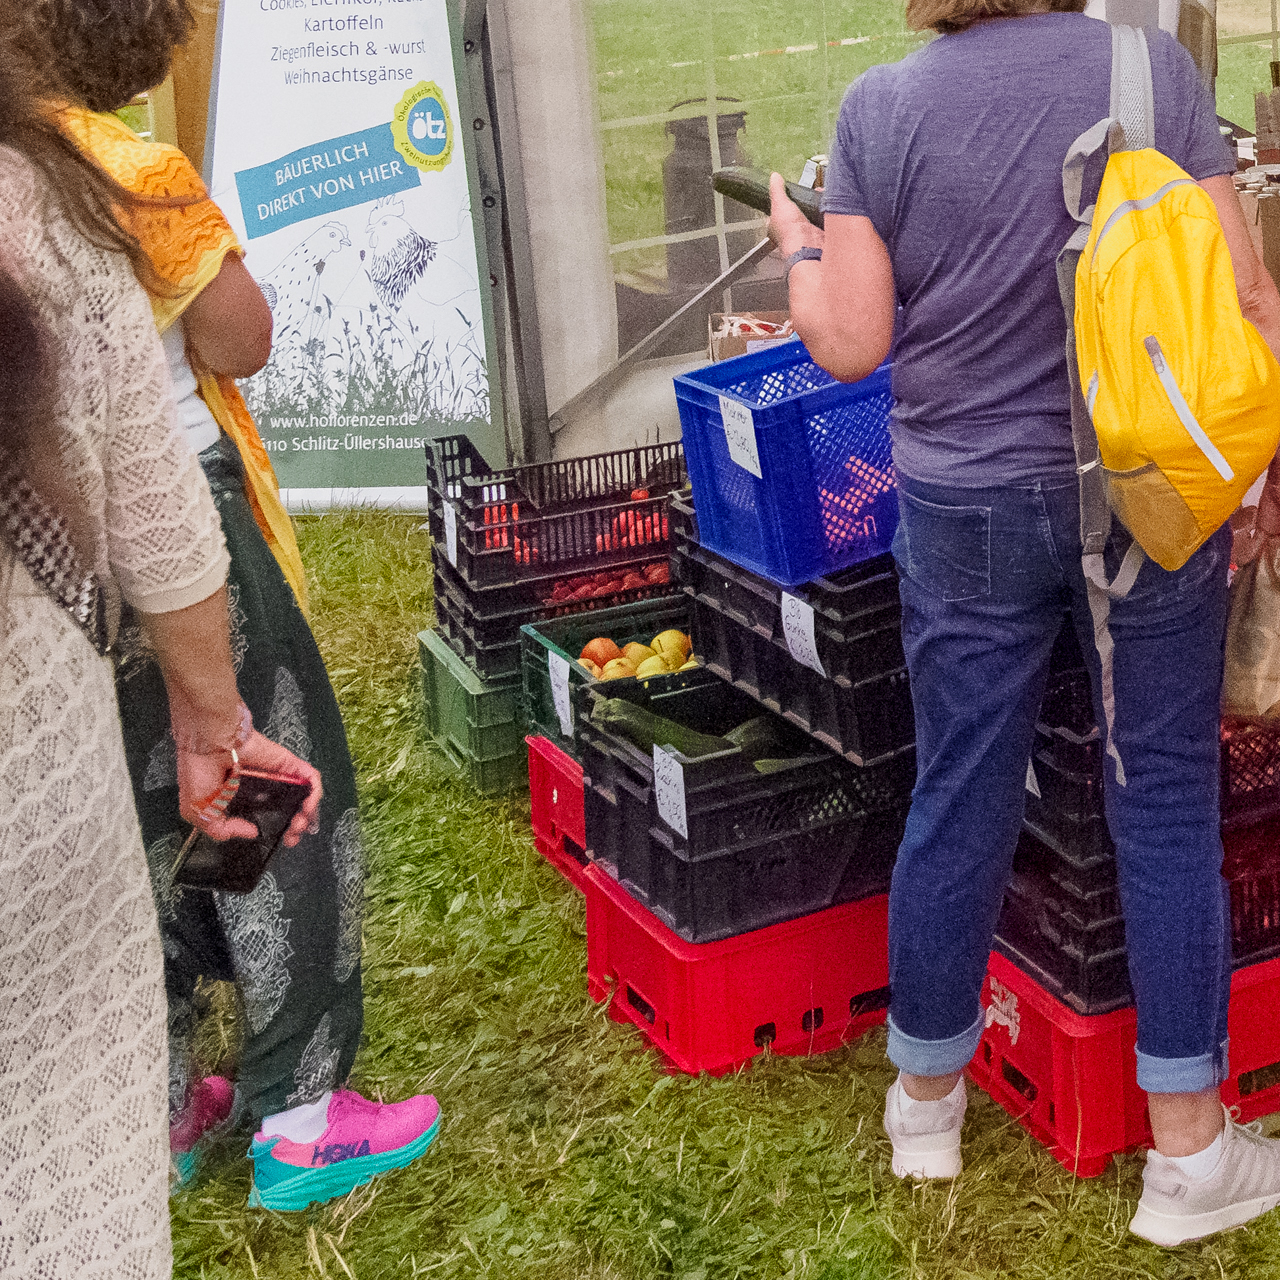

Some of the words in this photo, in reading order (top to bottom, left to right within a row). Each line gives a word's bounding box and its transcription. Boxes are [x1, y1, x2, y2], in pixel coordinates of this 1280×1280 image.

[304, 14, 385, 33] Kartoffeln
[270, 40, 360, 64] Ziegenfleisch
[365, 40, 378, 56] &
[383, 38, 427, 55] -wurst
[284, 65, 413, 86] Weihnachtsgänse
[274, 140, 369, 186] BÄUERLICH
[257, 187, 306, 221] DIREKT
[309, 173, 356, 200] VON
[359, 160, 404, 187] HIER
[269, 411, 419, 430] www.hoflorenzen.de
[311, 1139, 370, 1166] HOKA
